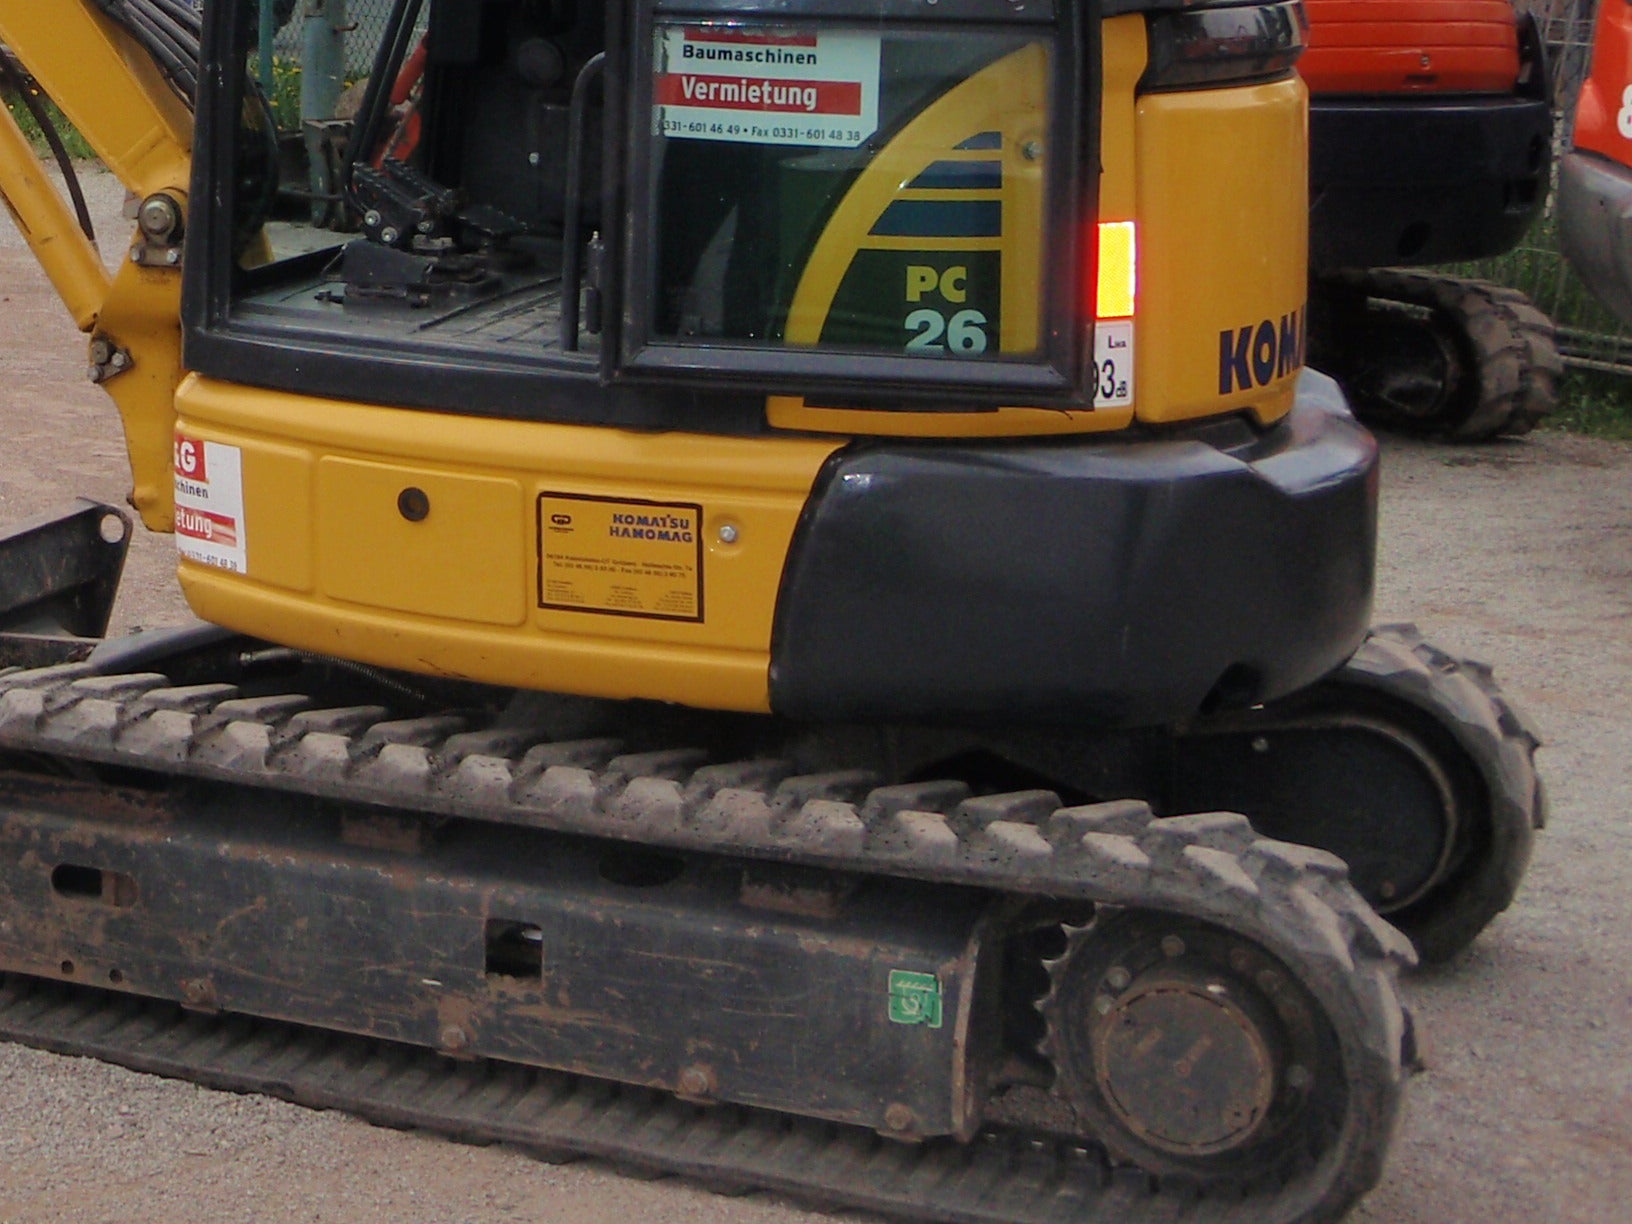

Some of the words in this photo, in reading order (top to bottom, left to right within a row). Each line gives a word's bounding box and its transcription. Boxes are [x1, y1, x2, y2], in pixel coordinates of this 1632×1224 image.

[683, 44, 817, 65] Baumaschinen
[682, 76, 817, 111] Vermietung
[664, 120, 707, 133] 331-601
[751, 126, 768, 137] Fax
[772, 127, 825, 140] 0331-601
[905, 265, 967, 303] PC
[904, 309, 988, 355] 26
[1094, 359, 1115, 400] 3
[609, 525, 693, 544] HANOMAG
[612, 513, 690, 529] KOMATSU
